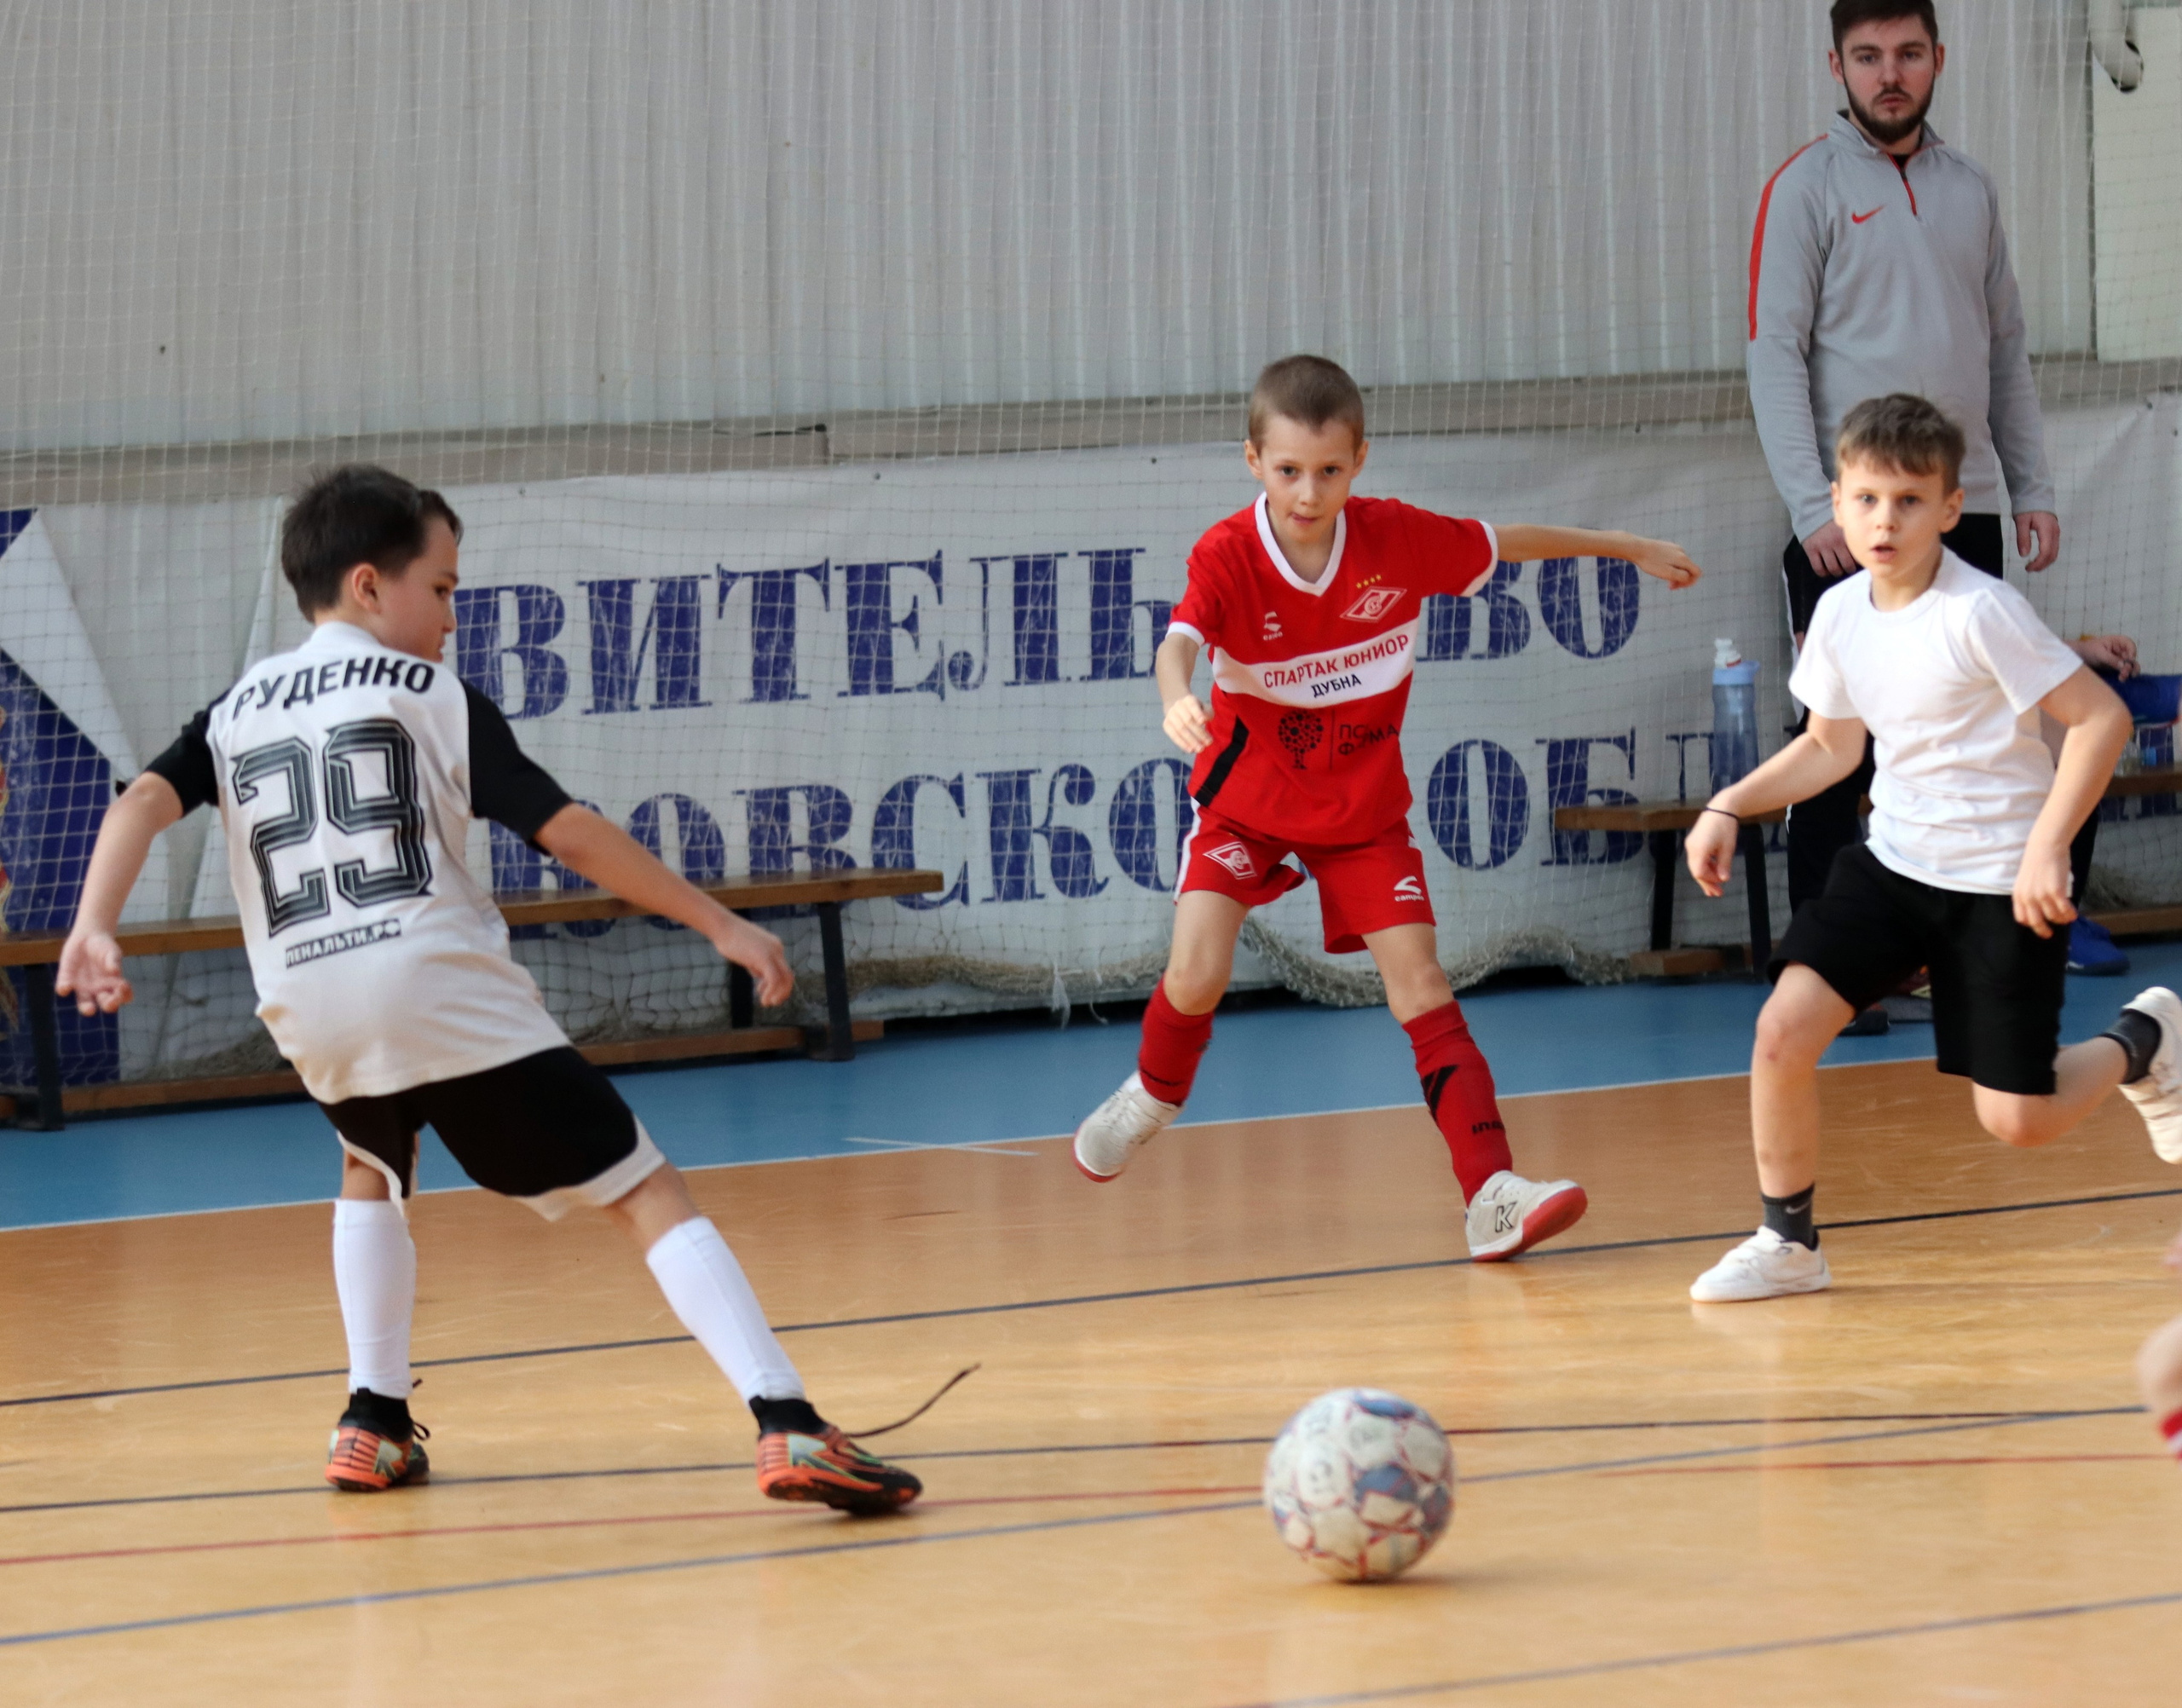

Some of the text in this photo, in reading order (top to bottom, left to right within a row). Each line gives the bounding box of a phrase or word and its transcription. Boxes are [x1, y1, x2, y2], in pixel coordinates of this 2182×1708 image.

[453, 548, 1640, 720] ВИТЕЛЬВО
[1264, 634, 1409, 688] СПАРТАК ЮНИОР
[233, 656, 436, 721] РУДЕНКО
[1311, 674, 1362, 699] ДУБНА
[231, 718, 435, 938] 29
[1494, 1200, 1517, 1233] K
